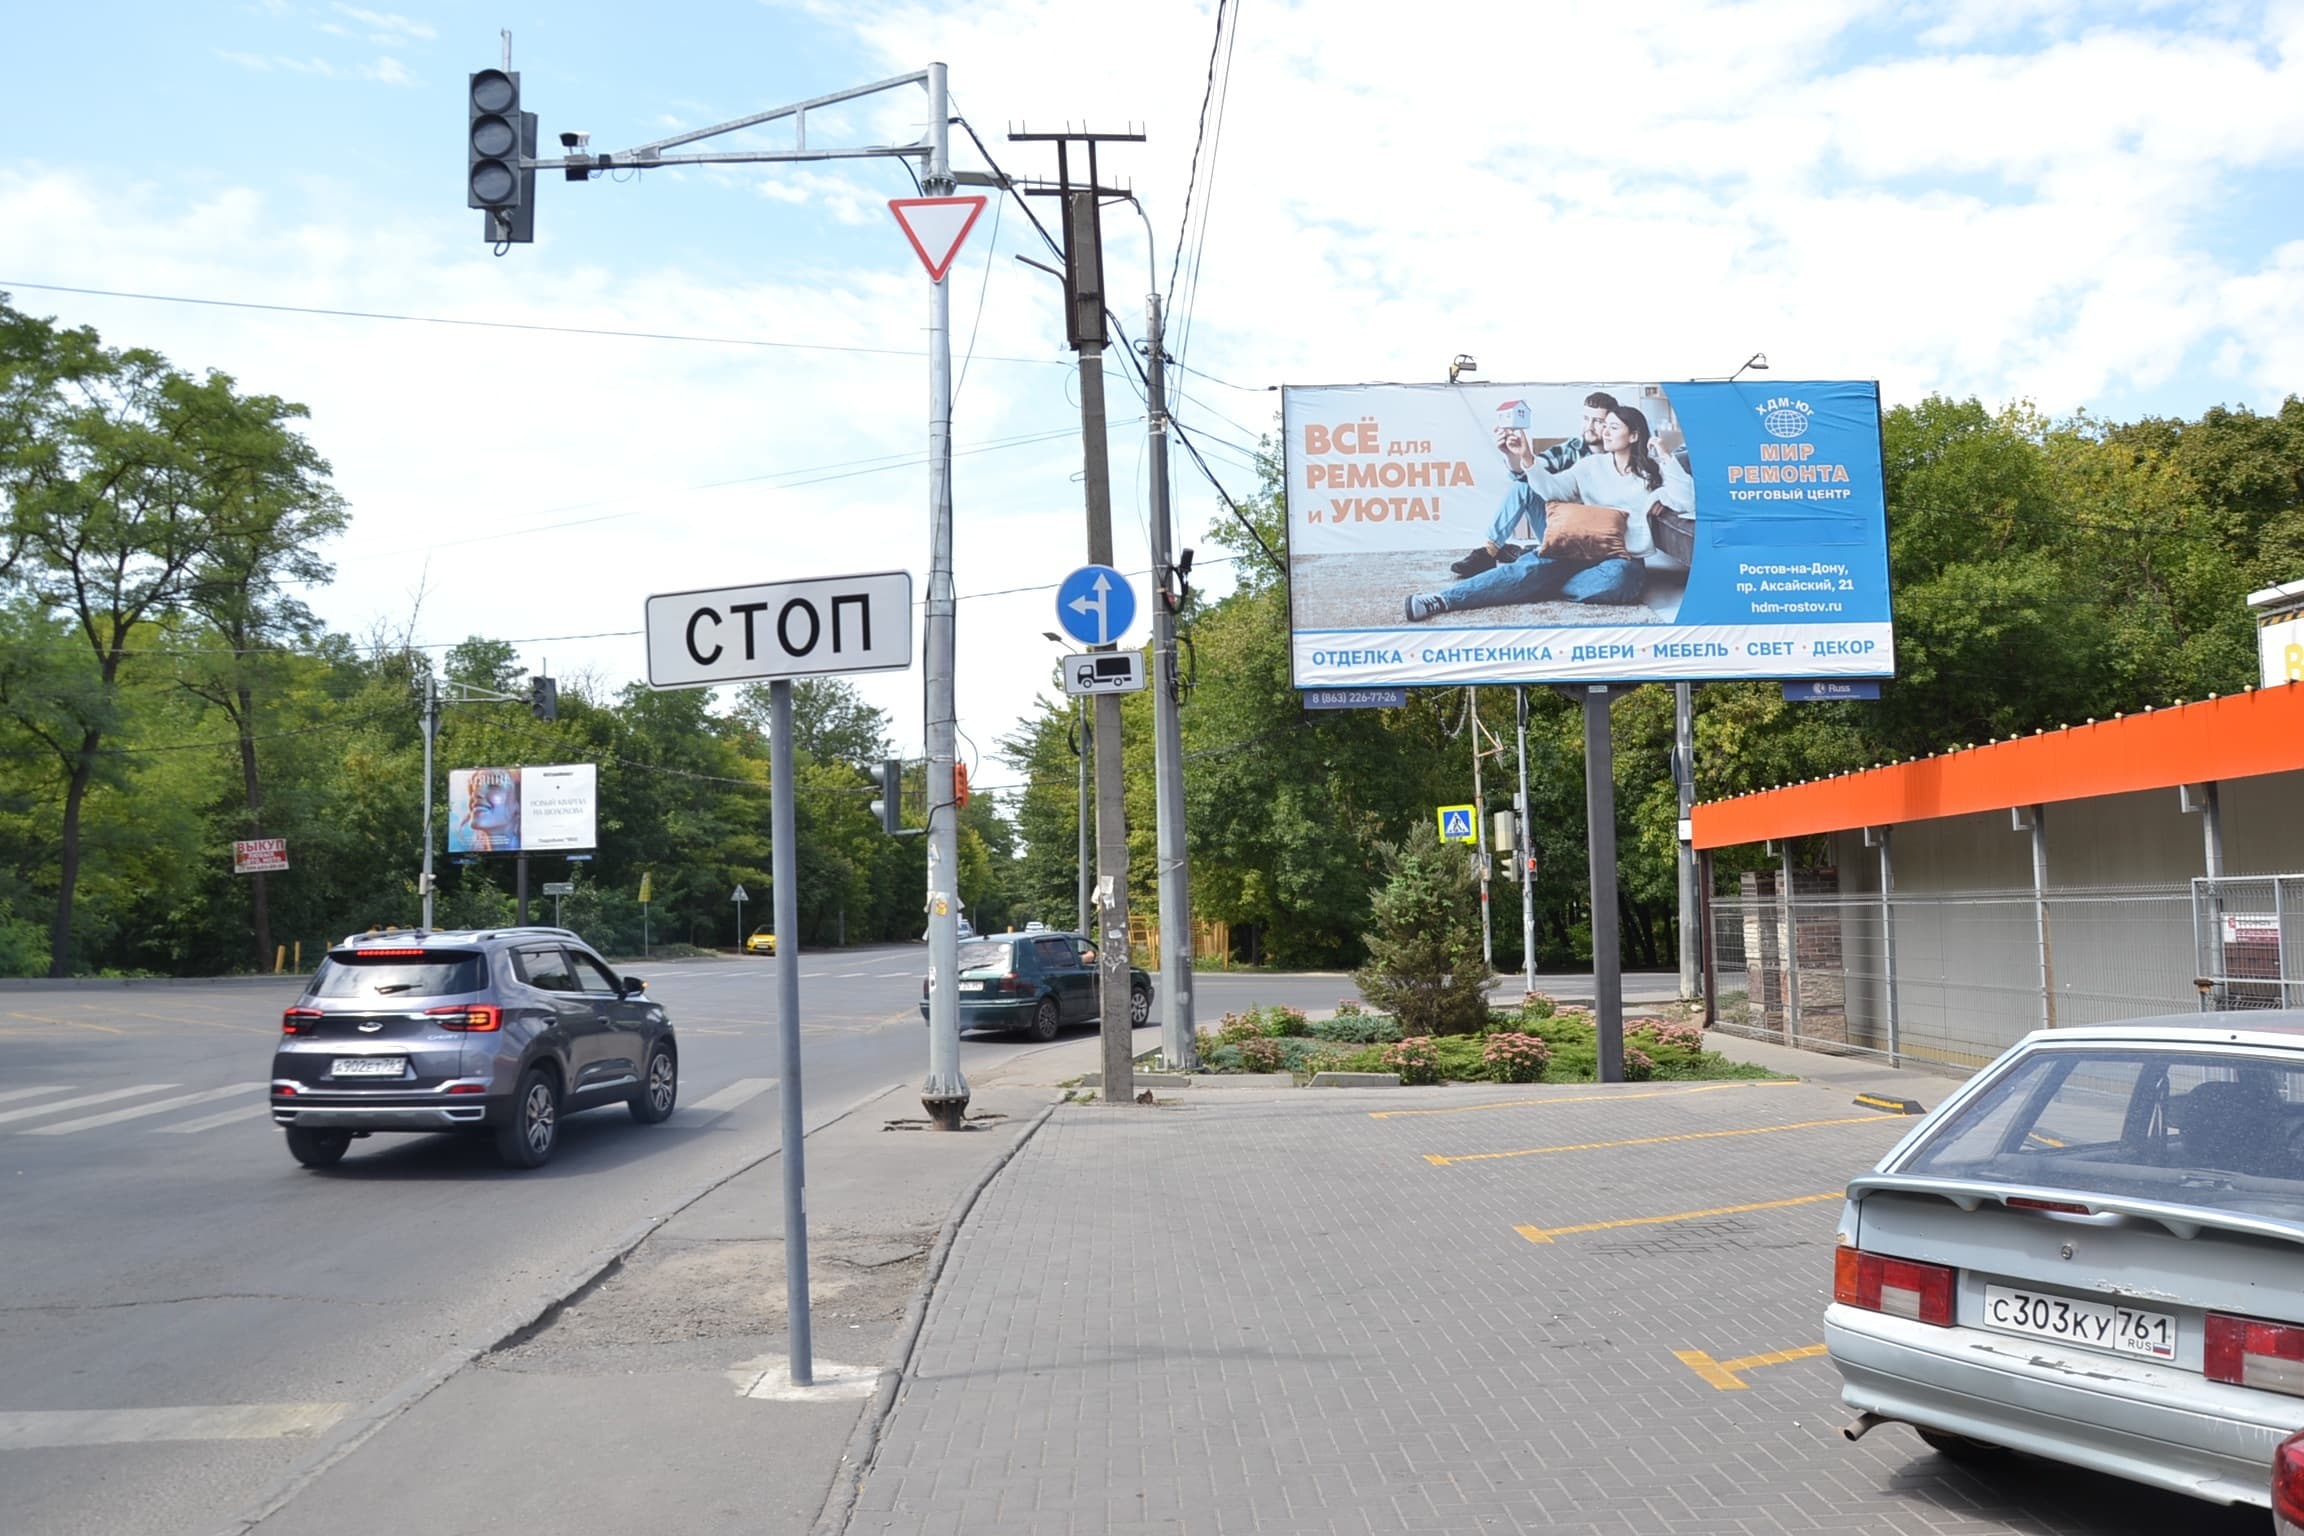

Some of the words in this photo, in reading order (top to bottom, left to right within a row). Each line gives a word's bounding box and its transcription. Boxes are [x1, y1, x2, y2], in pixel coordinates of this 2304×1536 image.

[1304, 416, 1380, 455] ВСЁ
[1387, 440, 1432, 456] для
[1760, 443, 1815, 462] МИР
[1306, 461, 1475, 489] РЕМОНТА
[1728, 464, 1850, 484] РЕМОНТА
[1729, 488, 1803, 500] ТОРГОВЫЙ
[1807, 489, 1851, 501] ЦЕНТР
[1308, 510, 1322, 523] и
[1330, 497, 1441, 523] УЮТА!
[1740, 562, 1849, 576] Ростов-на-Дону,
[1736, 582, 1757, 594] пр.
[1760, 579, 1836, 592] Аксайский,
[1838, 579, 1855, 591] 21
[1751, 601, 1843, 613] hdm-rostov.ru
[686, 593, 871, 666] СТОП
[1312, 650, 1403, 667] ОТДЕЛКА
[1421, 647, 1552, 663] САНТЕХНИКА
[1571, 645, 1635, 661] ДВЕРИ
[1653, 643, 1729, 658] МЕБЕЛЬ
[1746, 641, 1794, 656] СВЕТ
[1812, 640, 1875, 657] ДЕКОР
[1828, 684, 1851, 693] Russ
[1312, 693, 1319, 703] 8
[1321, 692, 1347, 704] (863)
[1349, 692, 1397, 703] 226-77-26
[236, 840, 284, 853] ВЫКУП
[2128, 1338, 2152, 1351] RUS
